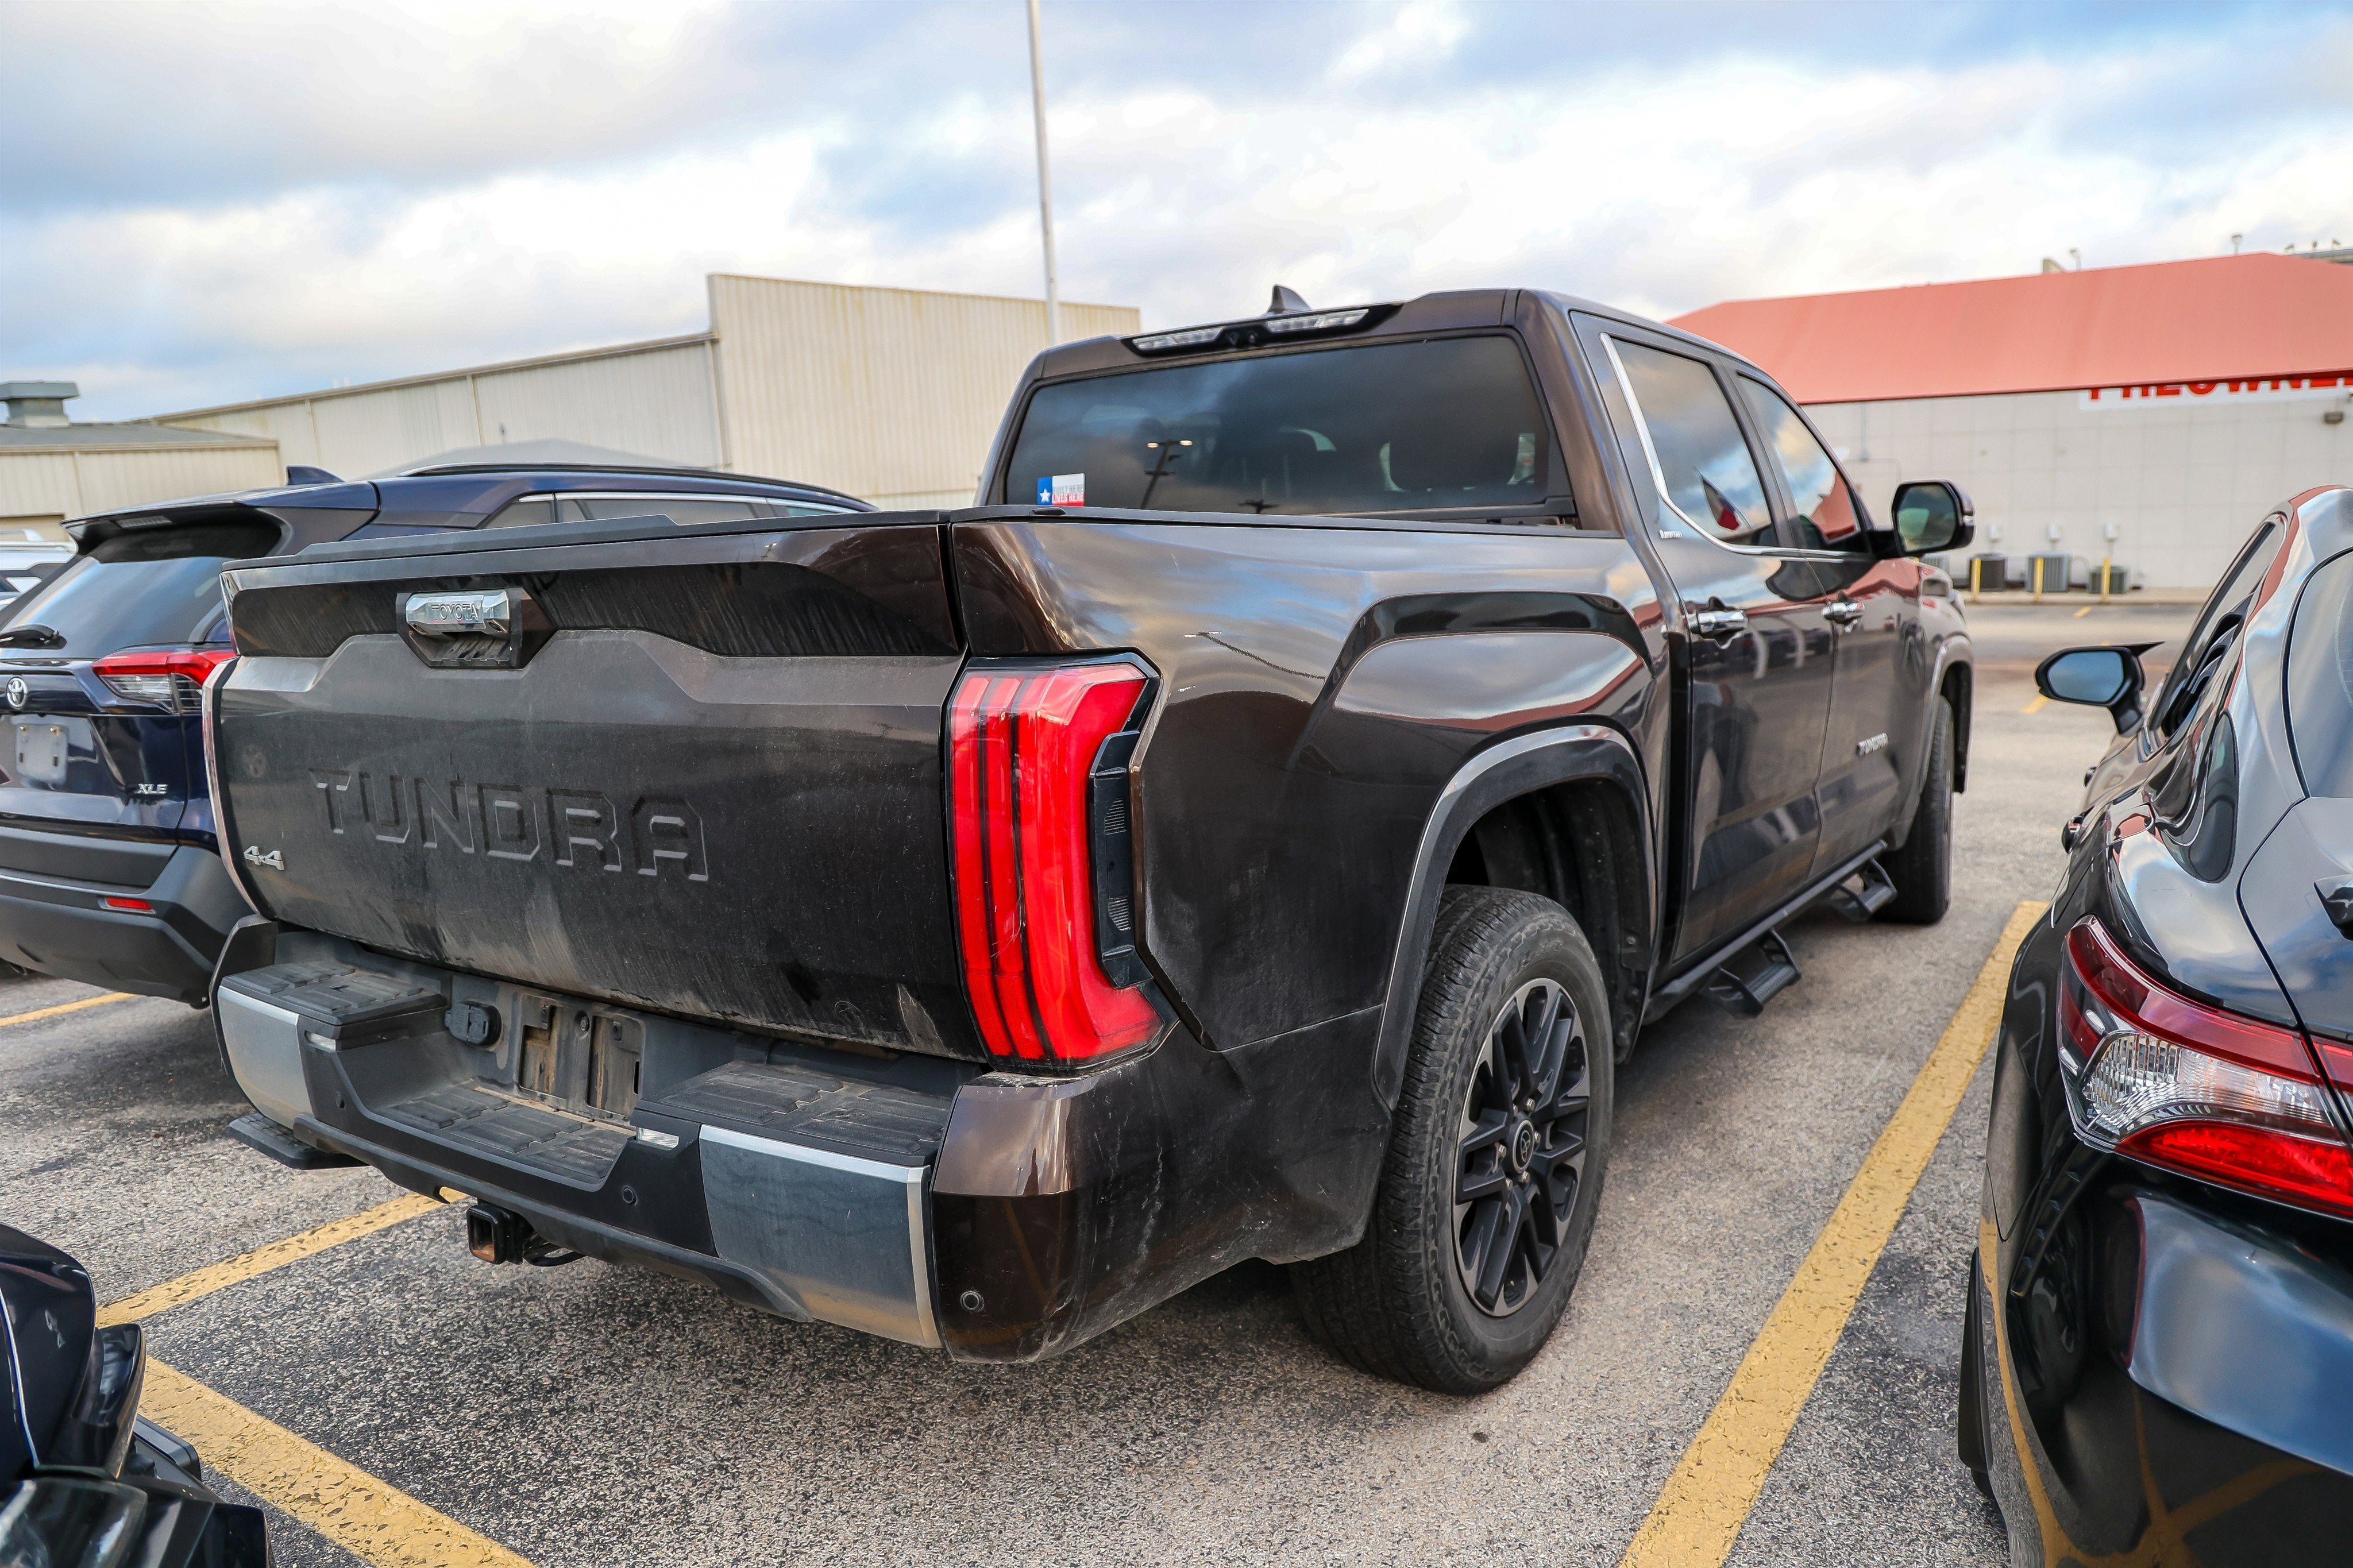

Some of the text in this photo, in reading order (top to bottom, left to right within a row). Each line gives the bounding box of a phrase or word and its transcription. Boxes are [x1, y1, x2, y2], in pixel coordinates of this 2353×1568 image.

[431, 603, 479, 621] TOYOTA
[135, 783, 168, 794] XLE
[308, 767, 708, 880] TUNDRA
